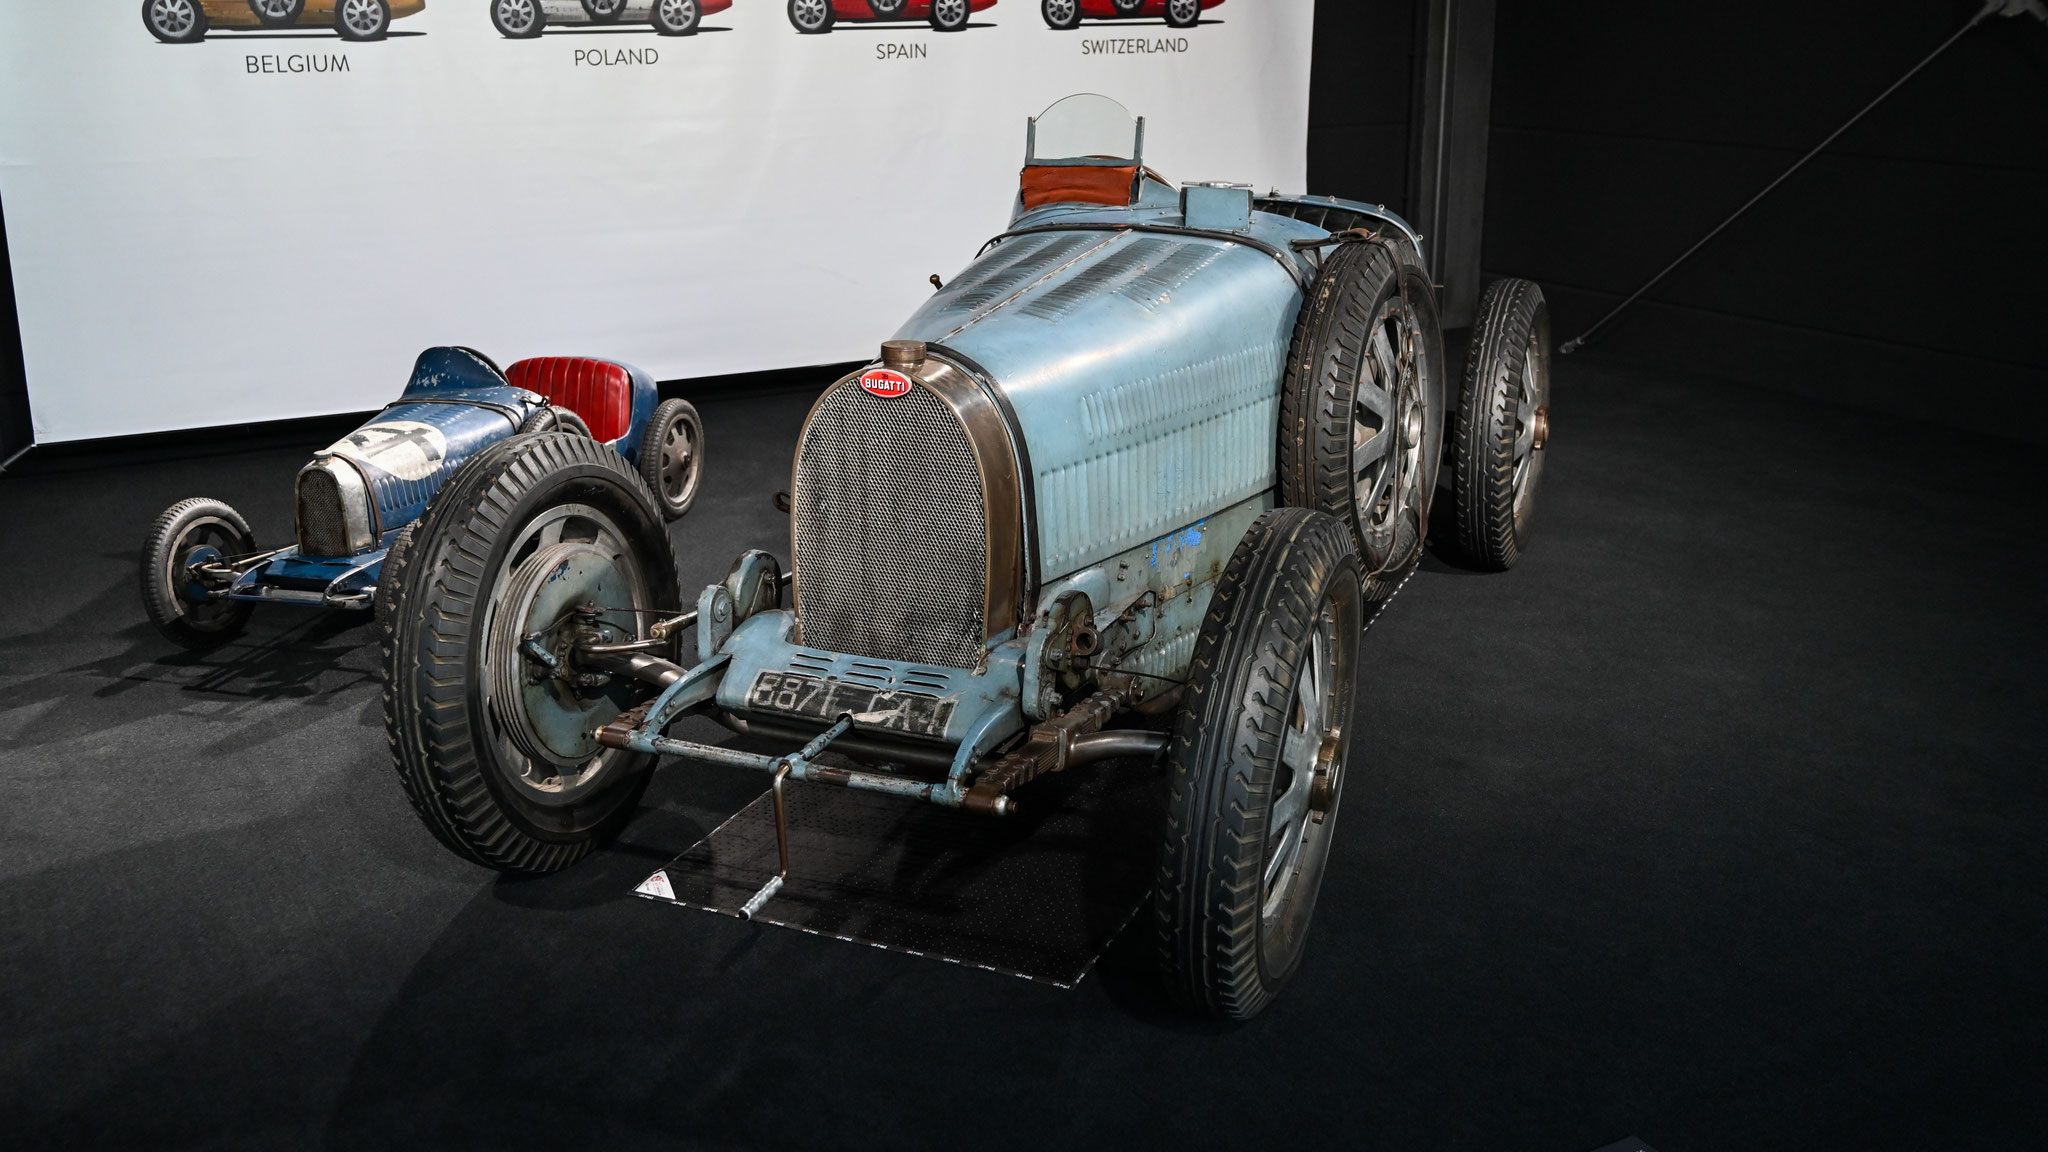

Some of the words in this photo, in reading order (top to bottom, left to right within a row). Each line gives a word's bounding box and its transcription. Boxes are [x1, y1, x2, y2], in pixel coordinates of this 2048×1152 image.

[876, 43, 927, 60] SPAIN
[1081, 37, 1189, 55] SWITZERLAND
[245, 54, 350, 73] BELGIUM
[574, 47, 659, 66] POLAND
[865, 379, 905, 391] BUGATTI
